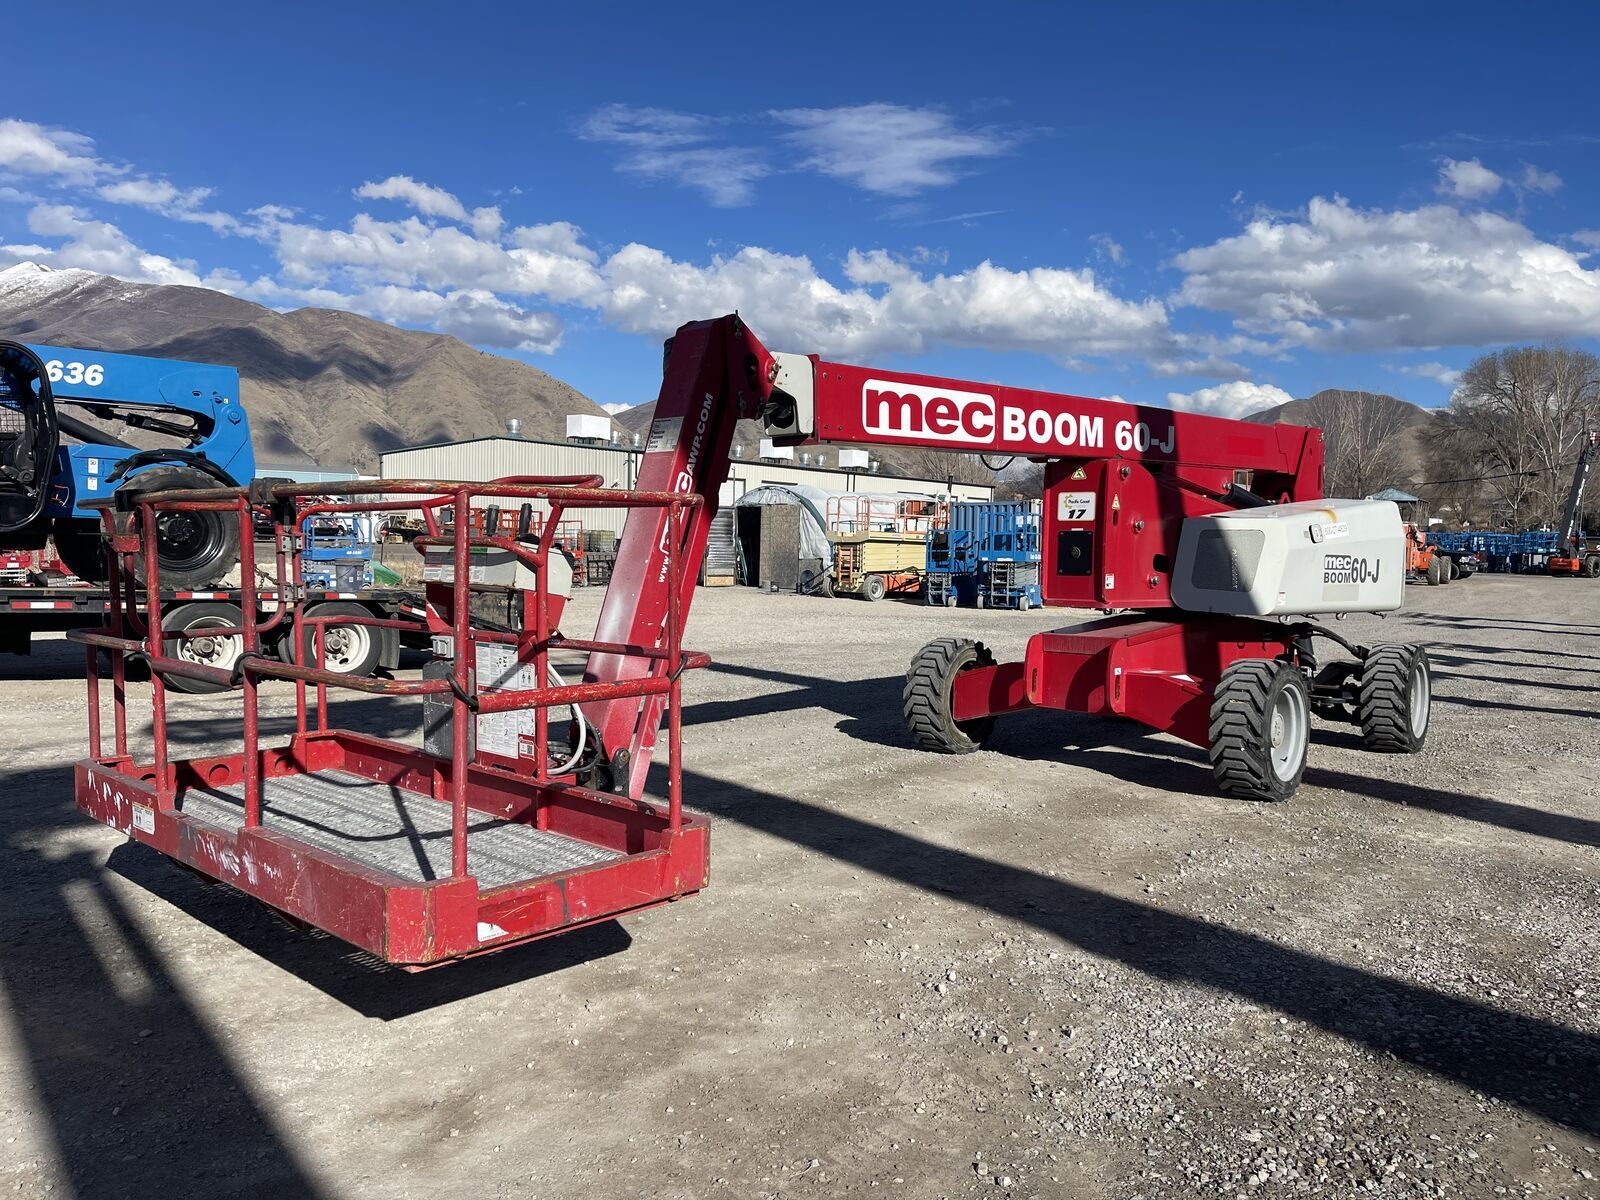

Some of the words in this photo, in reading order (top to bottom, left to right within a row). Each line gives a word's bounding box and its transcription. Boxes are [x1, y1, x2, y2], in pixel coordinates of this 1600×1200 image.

[45, 360, 104, 386] 636
[865, 388, 994, 438] mec
[1003, 406, 1104, 448] BOOM
[1114, 420, 1175, 454] 60-J
[1068, 509, 1087, 519] 17
[1324, 555, 1351, 570] mec
[1351, 558, 1380, 583] 60-J
[1323, 572, 1351, 583] BOOM
